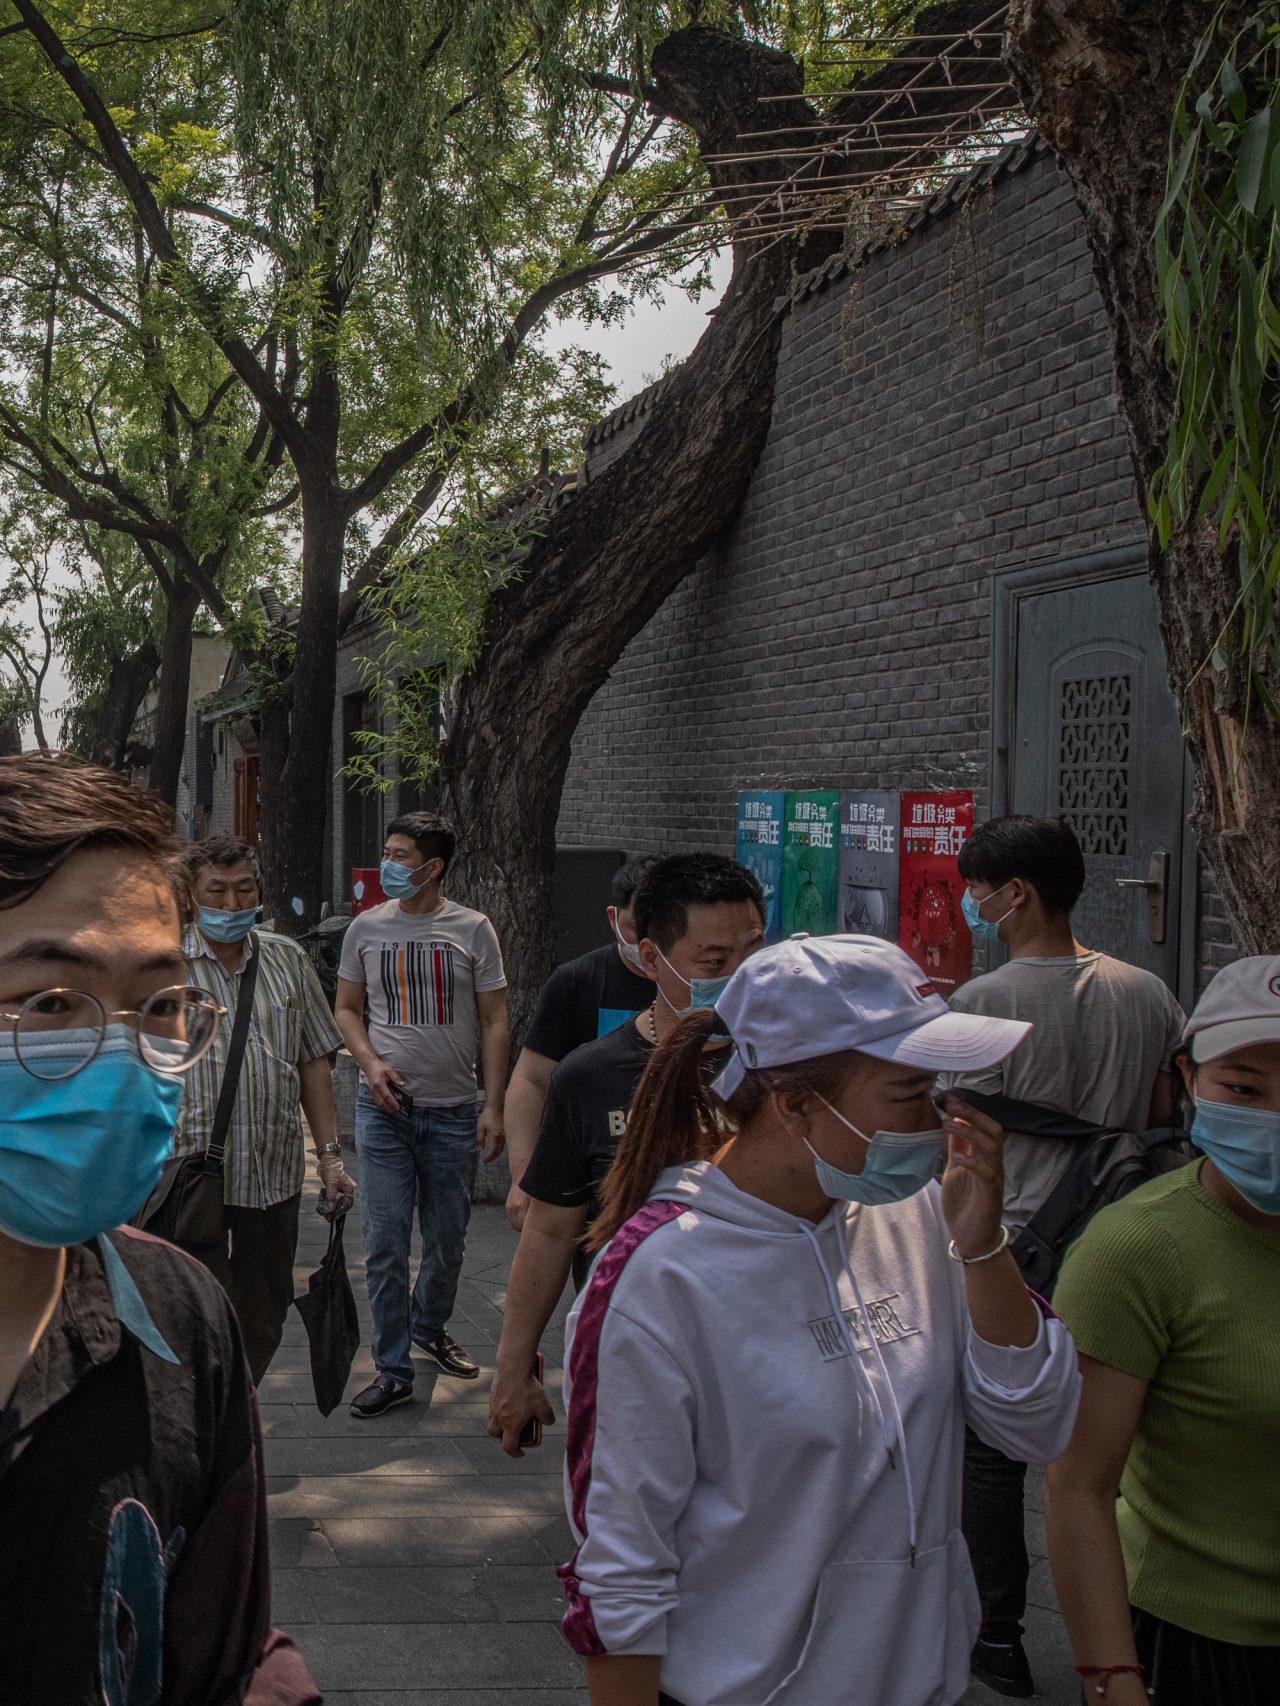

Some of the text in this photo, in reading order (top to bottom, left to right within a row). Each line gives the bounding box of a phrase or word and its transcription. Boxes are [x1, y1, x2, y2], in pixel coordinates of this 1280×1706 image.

[745, 802, 773, 819] 垃圾分类
[795, 802, 827, 820] 垃圾分类
[849, 803, 886, 823] 垃圾分类
[912, 803, 956, 824] 垃圾分类
[808, 1311, 859, 1357] HAPY
